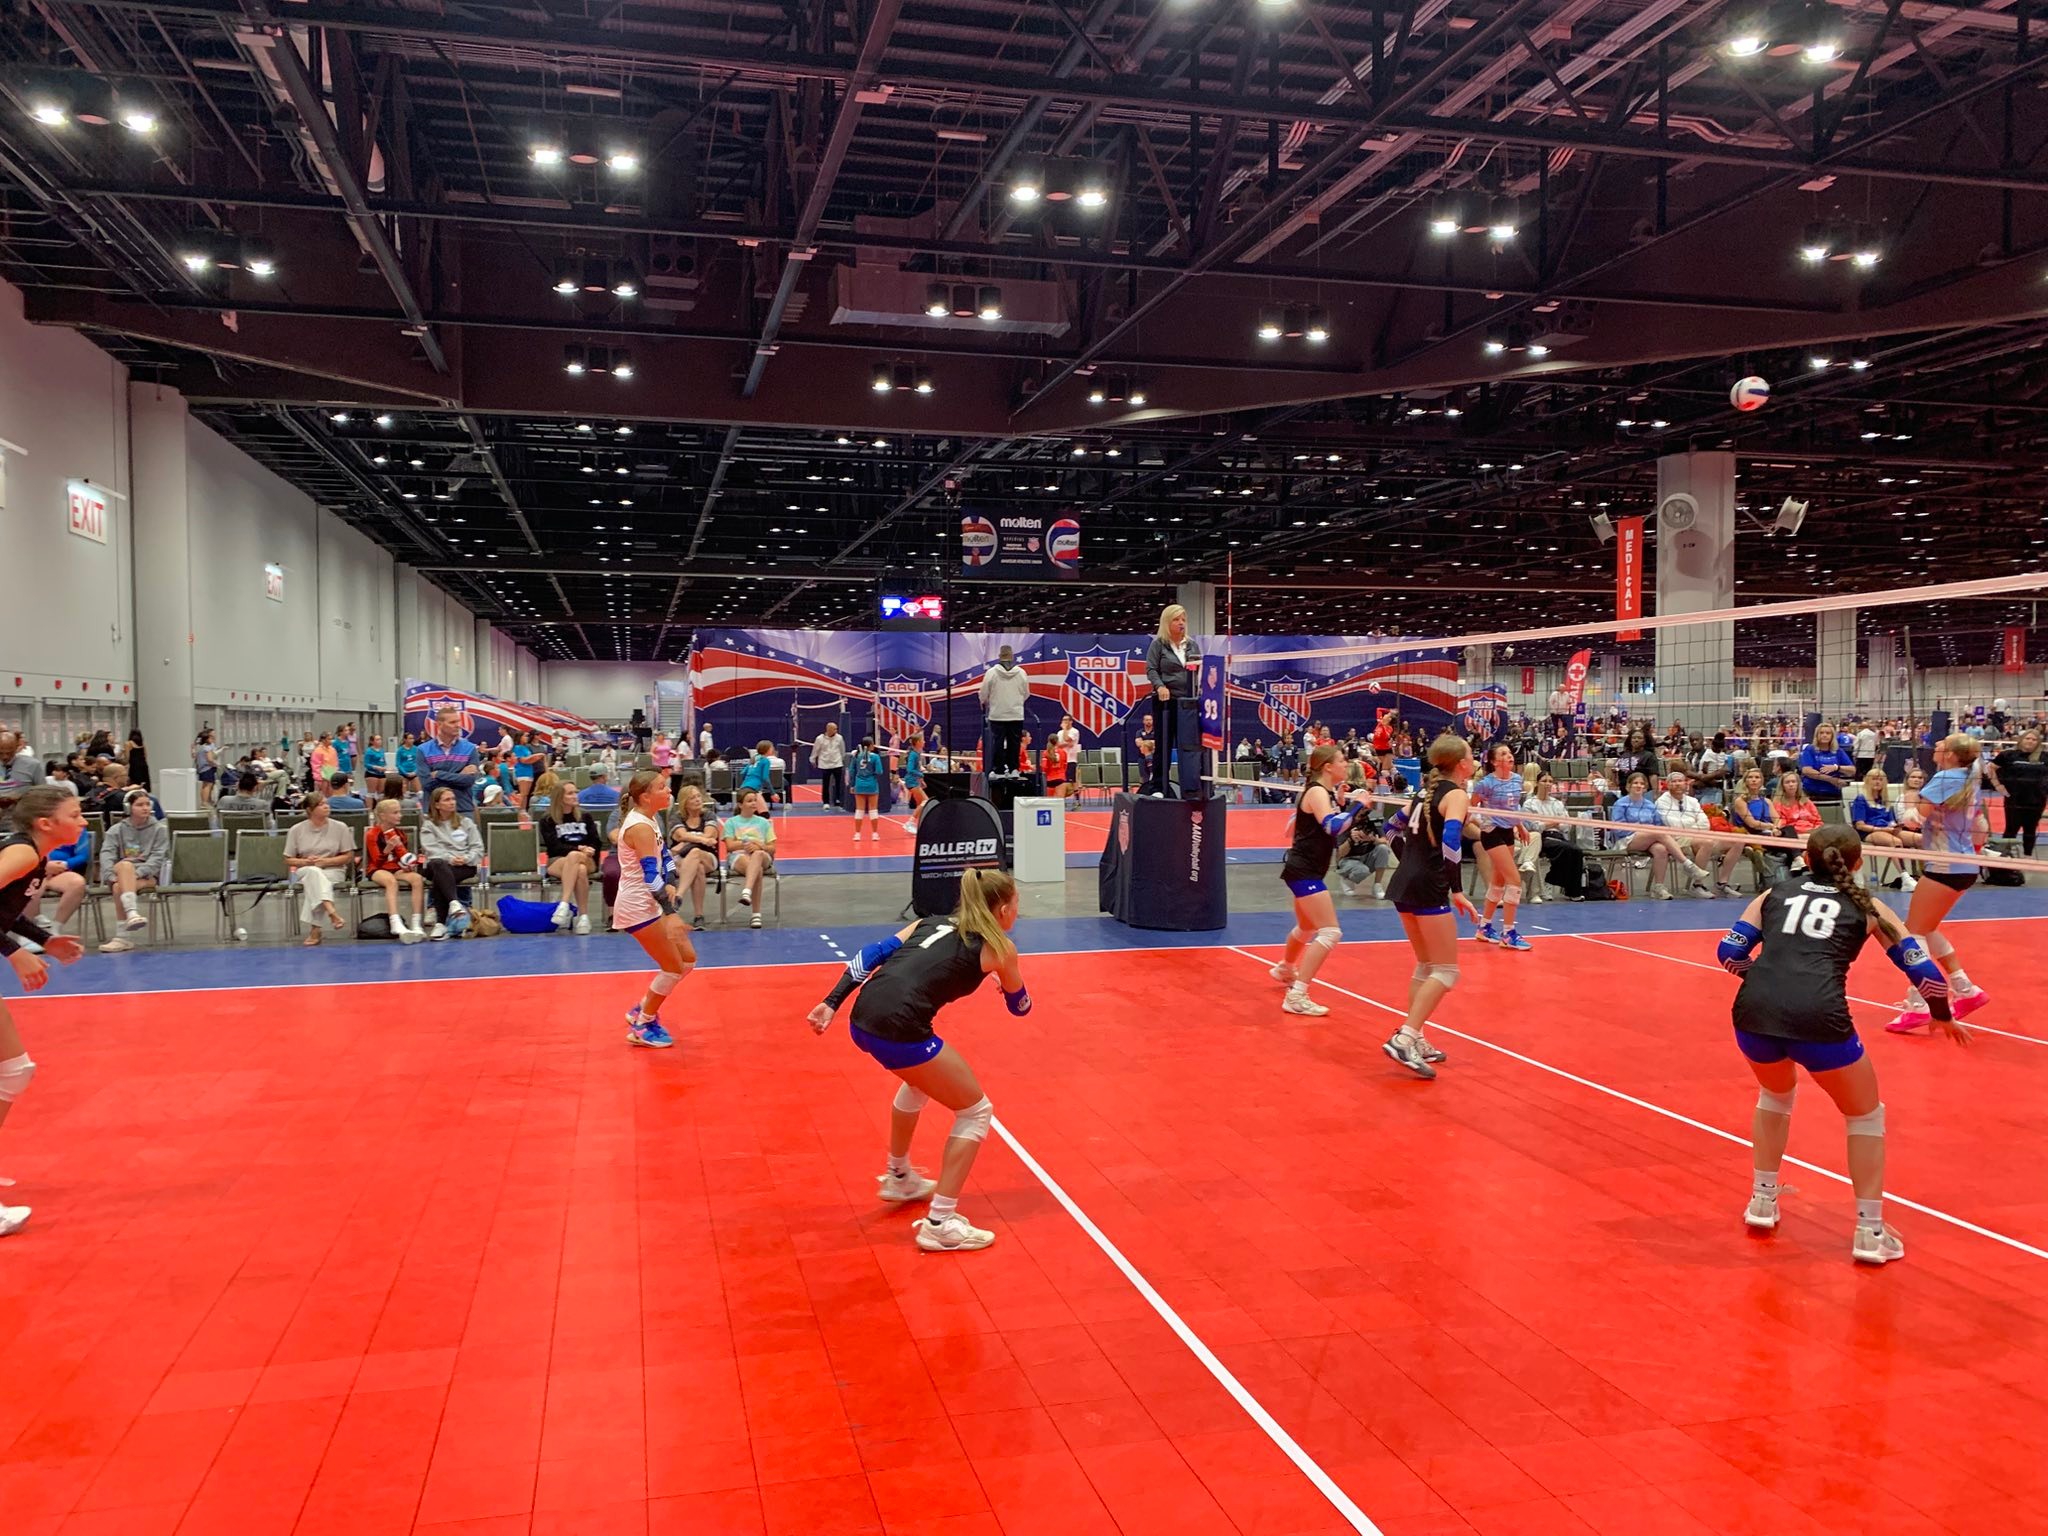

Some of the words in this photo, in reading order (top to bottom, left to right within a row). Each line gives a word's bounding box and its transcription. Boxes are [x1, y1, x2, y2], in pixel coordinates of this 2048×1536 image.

[71, 494, 104, 537] EXIT
[1000, 517, 1042, 529] molten
[1625, 529, 1635, 611] MEDICAL
[1078, 657, 1118, 669] AAU
[886, 683, 918, 692] AAU
[1076, 676, 1118, 715] USA
[1271, 684, 1300, 692] AAU
[886, 697, 918, 725] USA
[1204, 699, 1218, 721] 93
[1269, 696, 1299, 726] USA
[1408, 801, 1424, 835] 4
[919, 841, 976, 857] BALLER
[1781, 894, 1842, 940] 18
